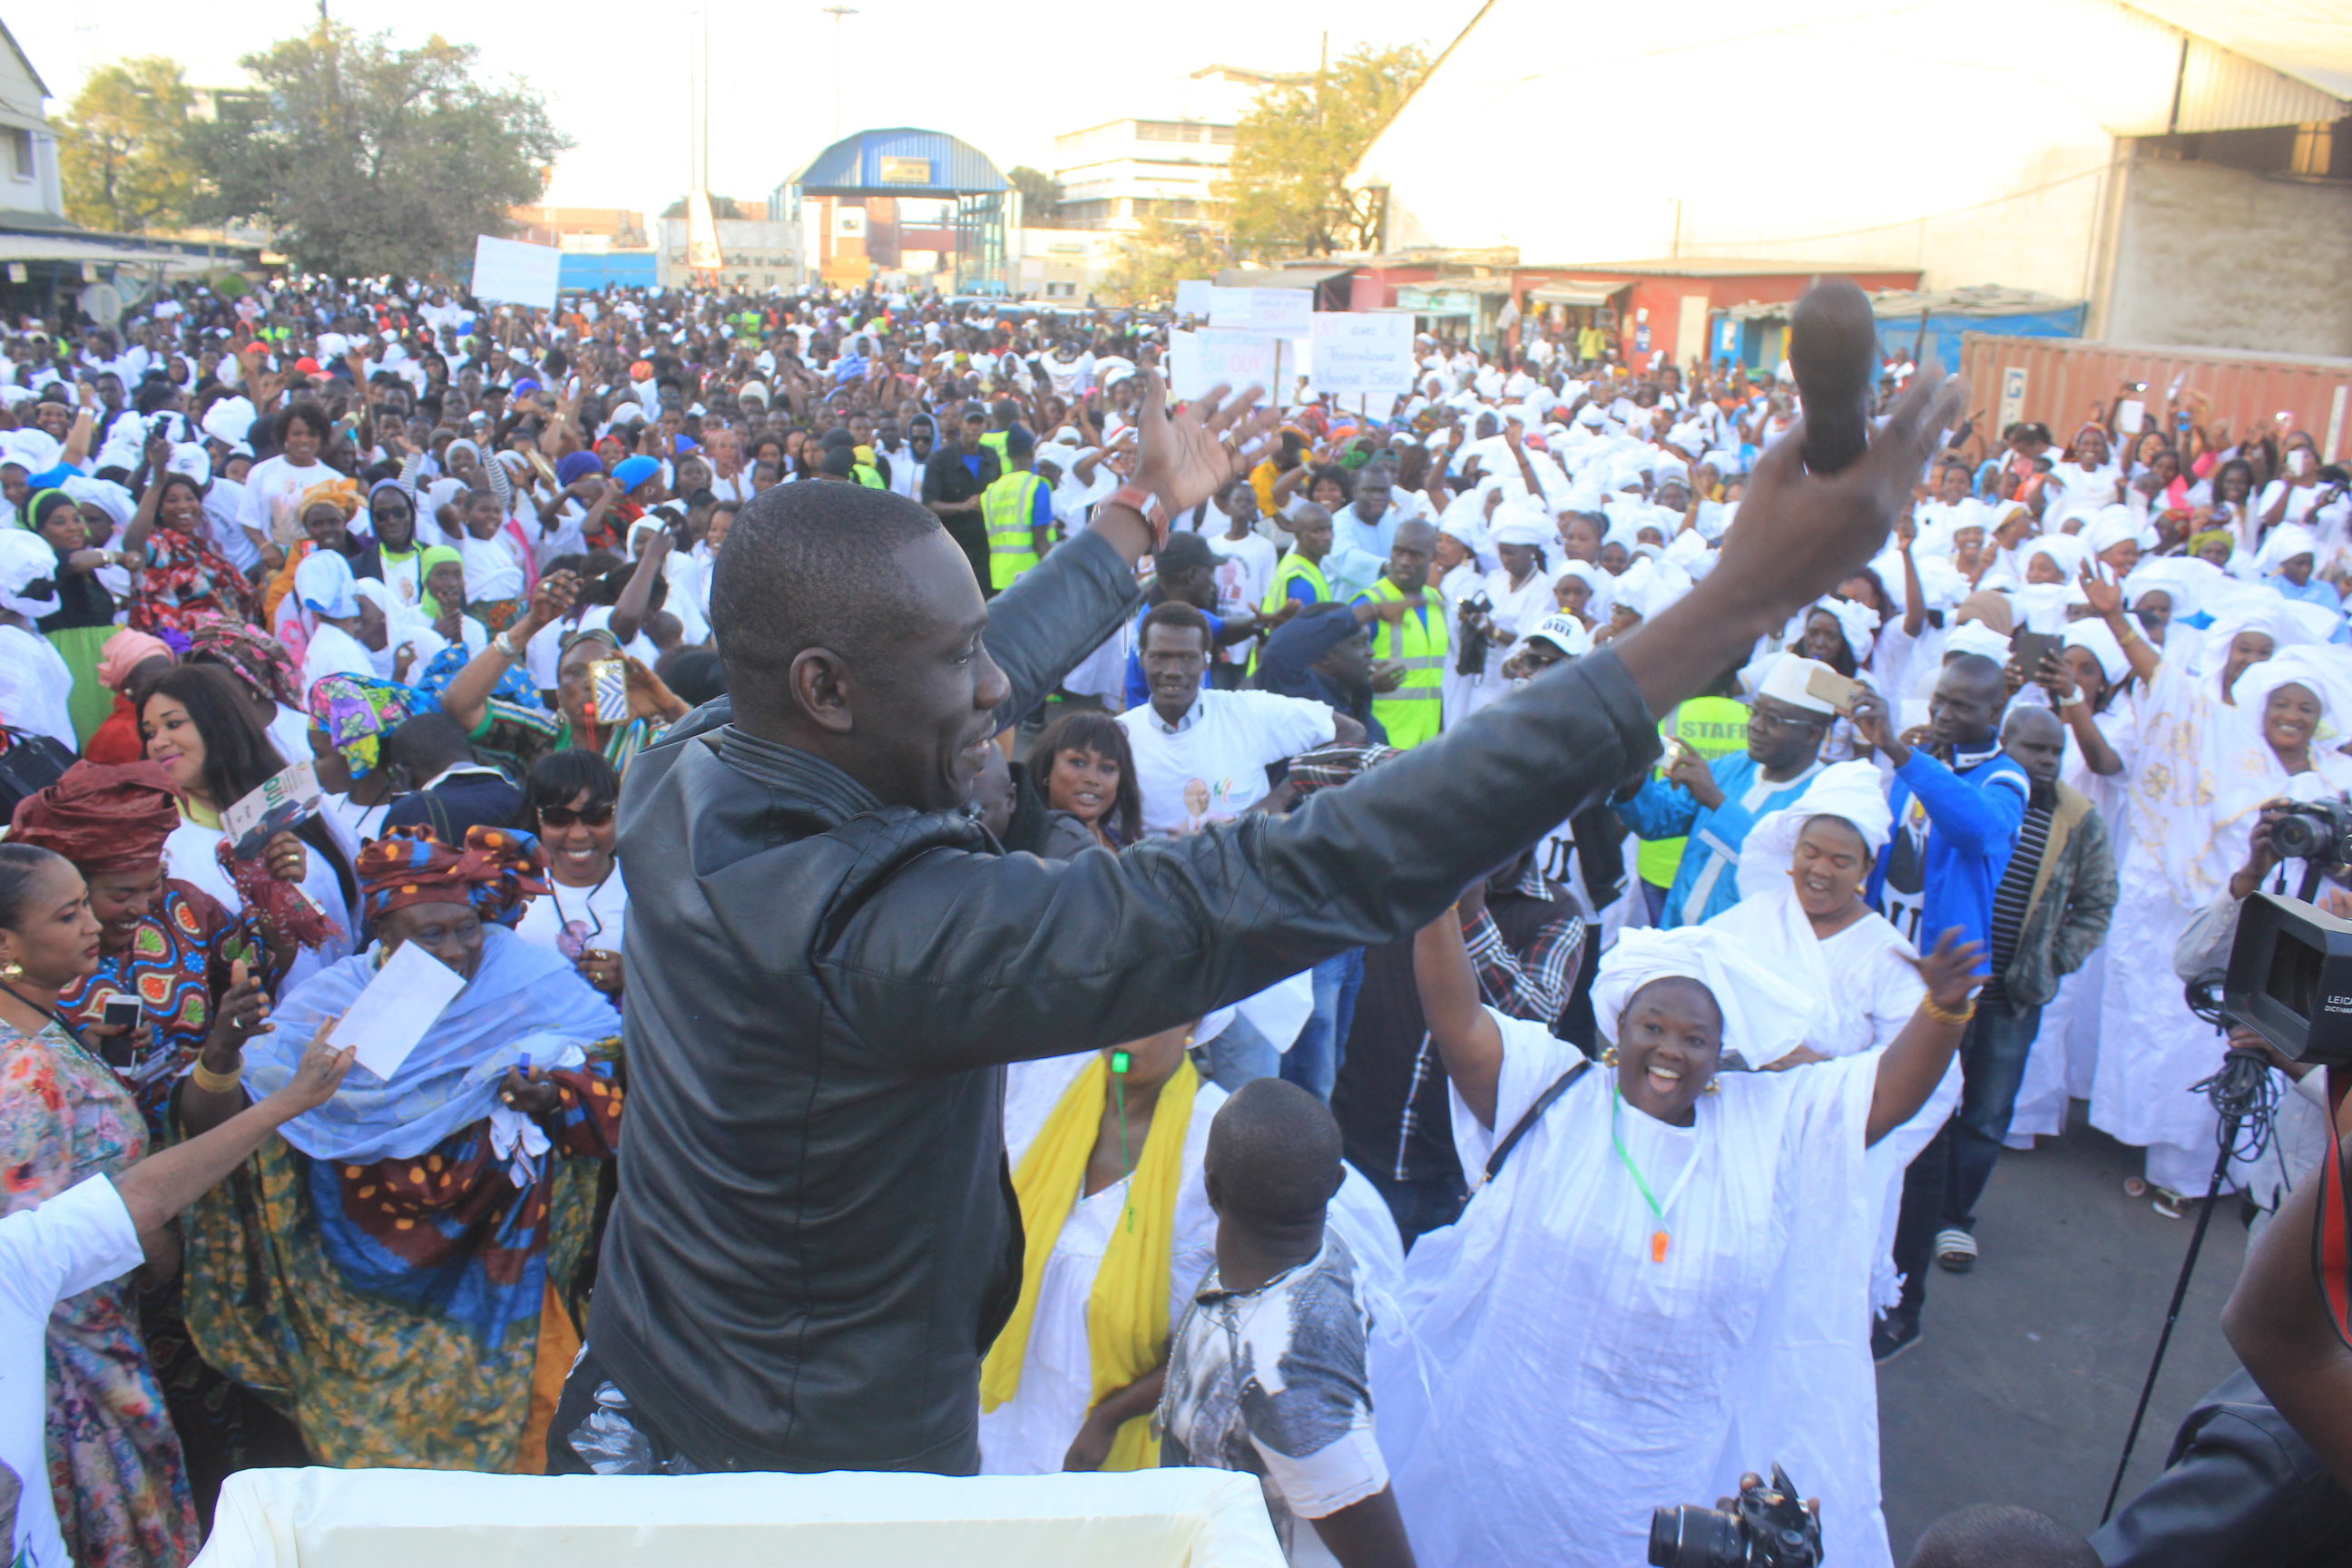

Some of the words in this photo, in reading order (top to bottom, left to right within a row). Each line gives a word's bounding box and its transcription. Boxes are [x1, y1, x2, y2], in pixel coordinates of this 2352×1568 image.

[1314, 318, 1338, 336] OUI
[1230, 354, 1259, 372] OUI
[1681, 720, 1748, 739] STAFF
[263, 777, 284, 807] OUI
